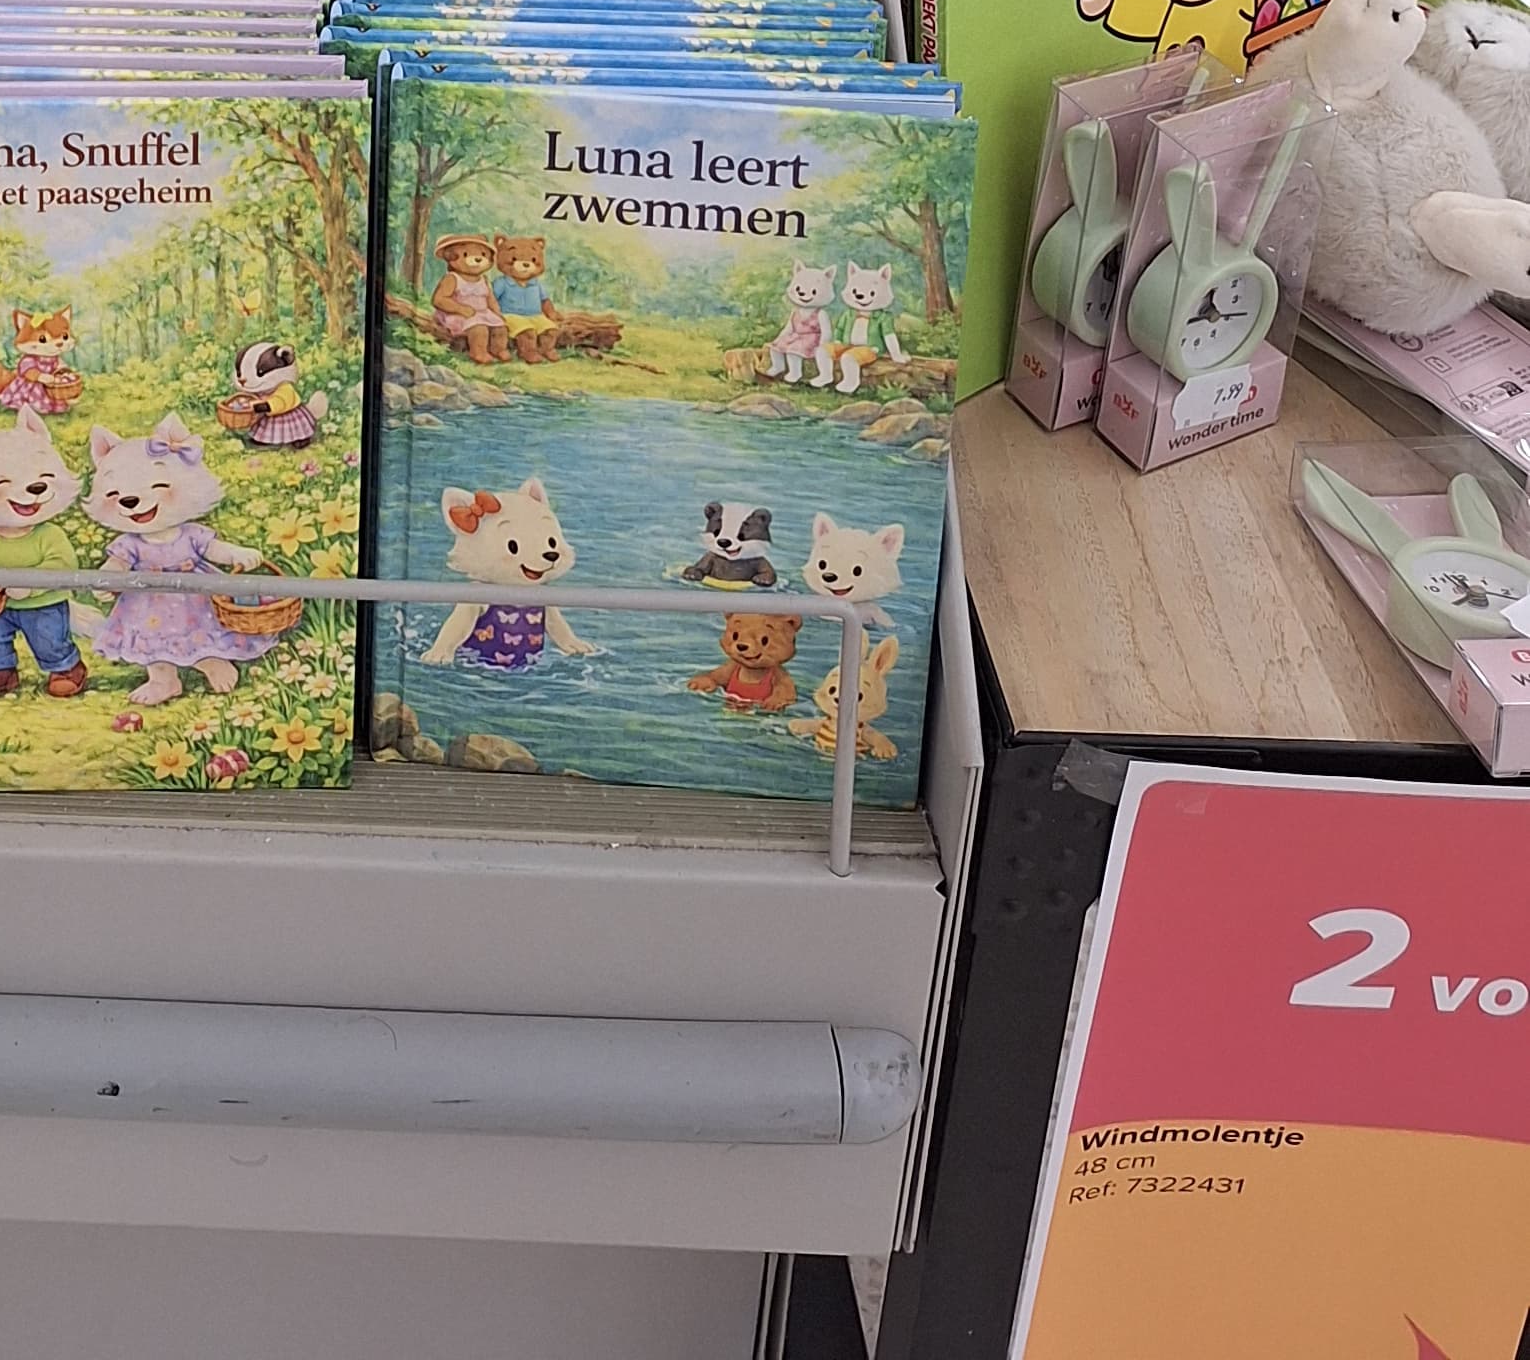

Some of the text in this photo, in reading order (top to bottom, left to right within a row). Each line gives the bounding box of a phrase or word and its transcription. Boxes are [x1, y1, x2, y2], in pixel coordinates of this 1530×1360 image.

[62, 132, 202, 169] Snuffel
[543, 130, 810, 190] Luna leert
[37, 181, 212, 212] paasgeheim
[542, 190, 808, 239] zwemmen
[1214, 382, 1244, 405] 7.99
[1168, 406, 1265, 451] Wonder time
[1289, 908, 1411, 1009] 2
[1080, 1124, 1305, 1153] Windmolentje
[1074, 1151, 1155, 1177] 48 cm
[1069, 1176, 1245, 1205] Ref: 7322431
